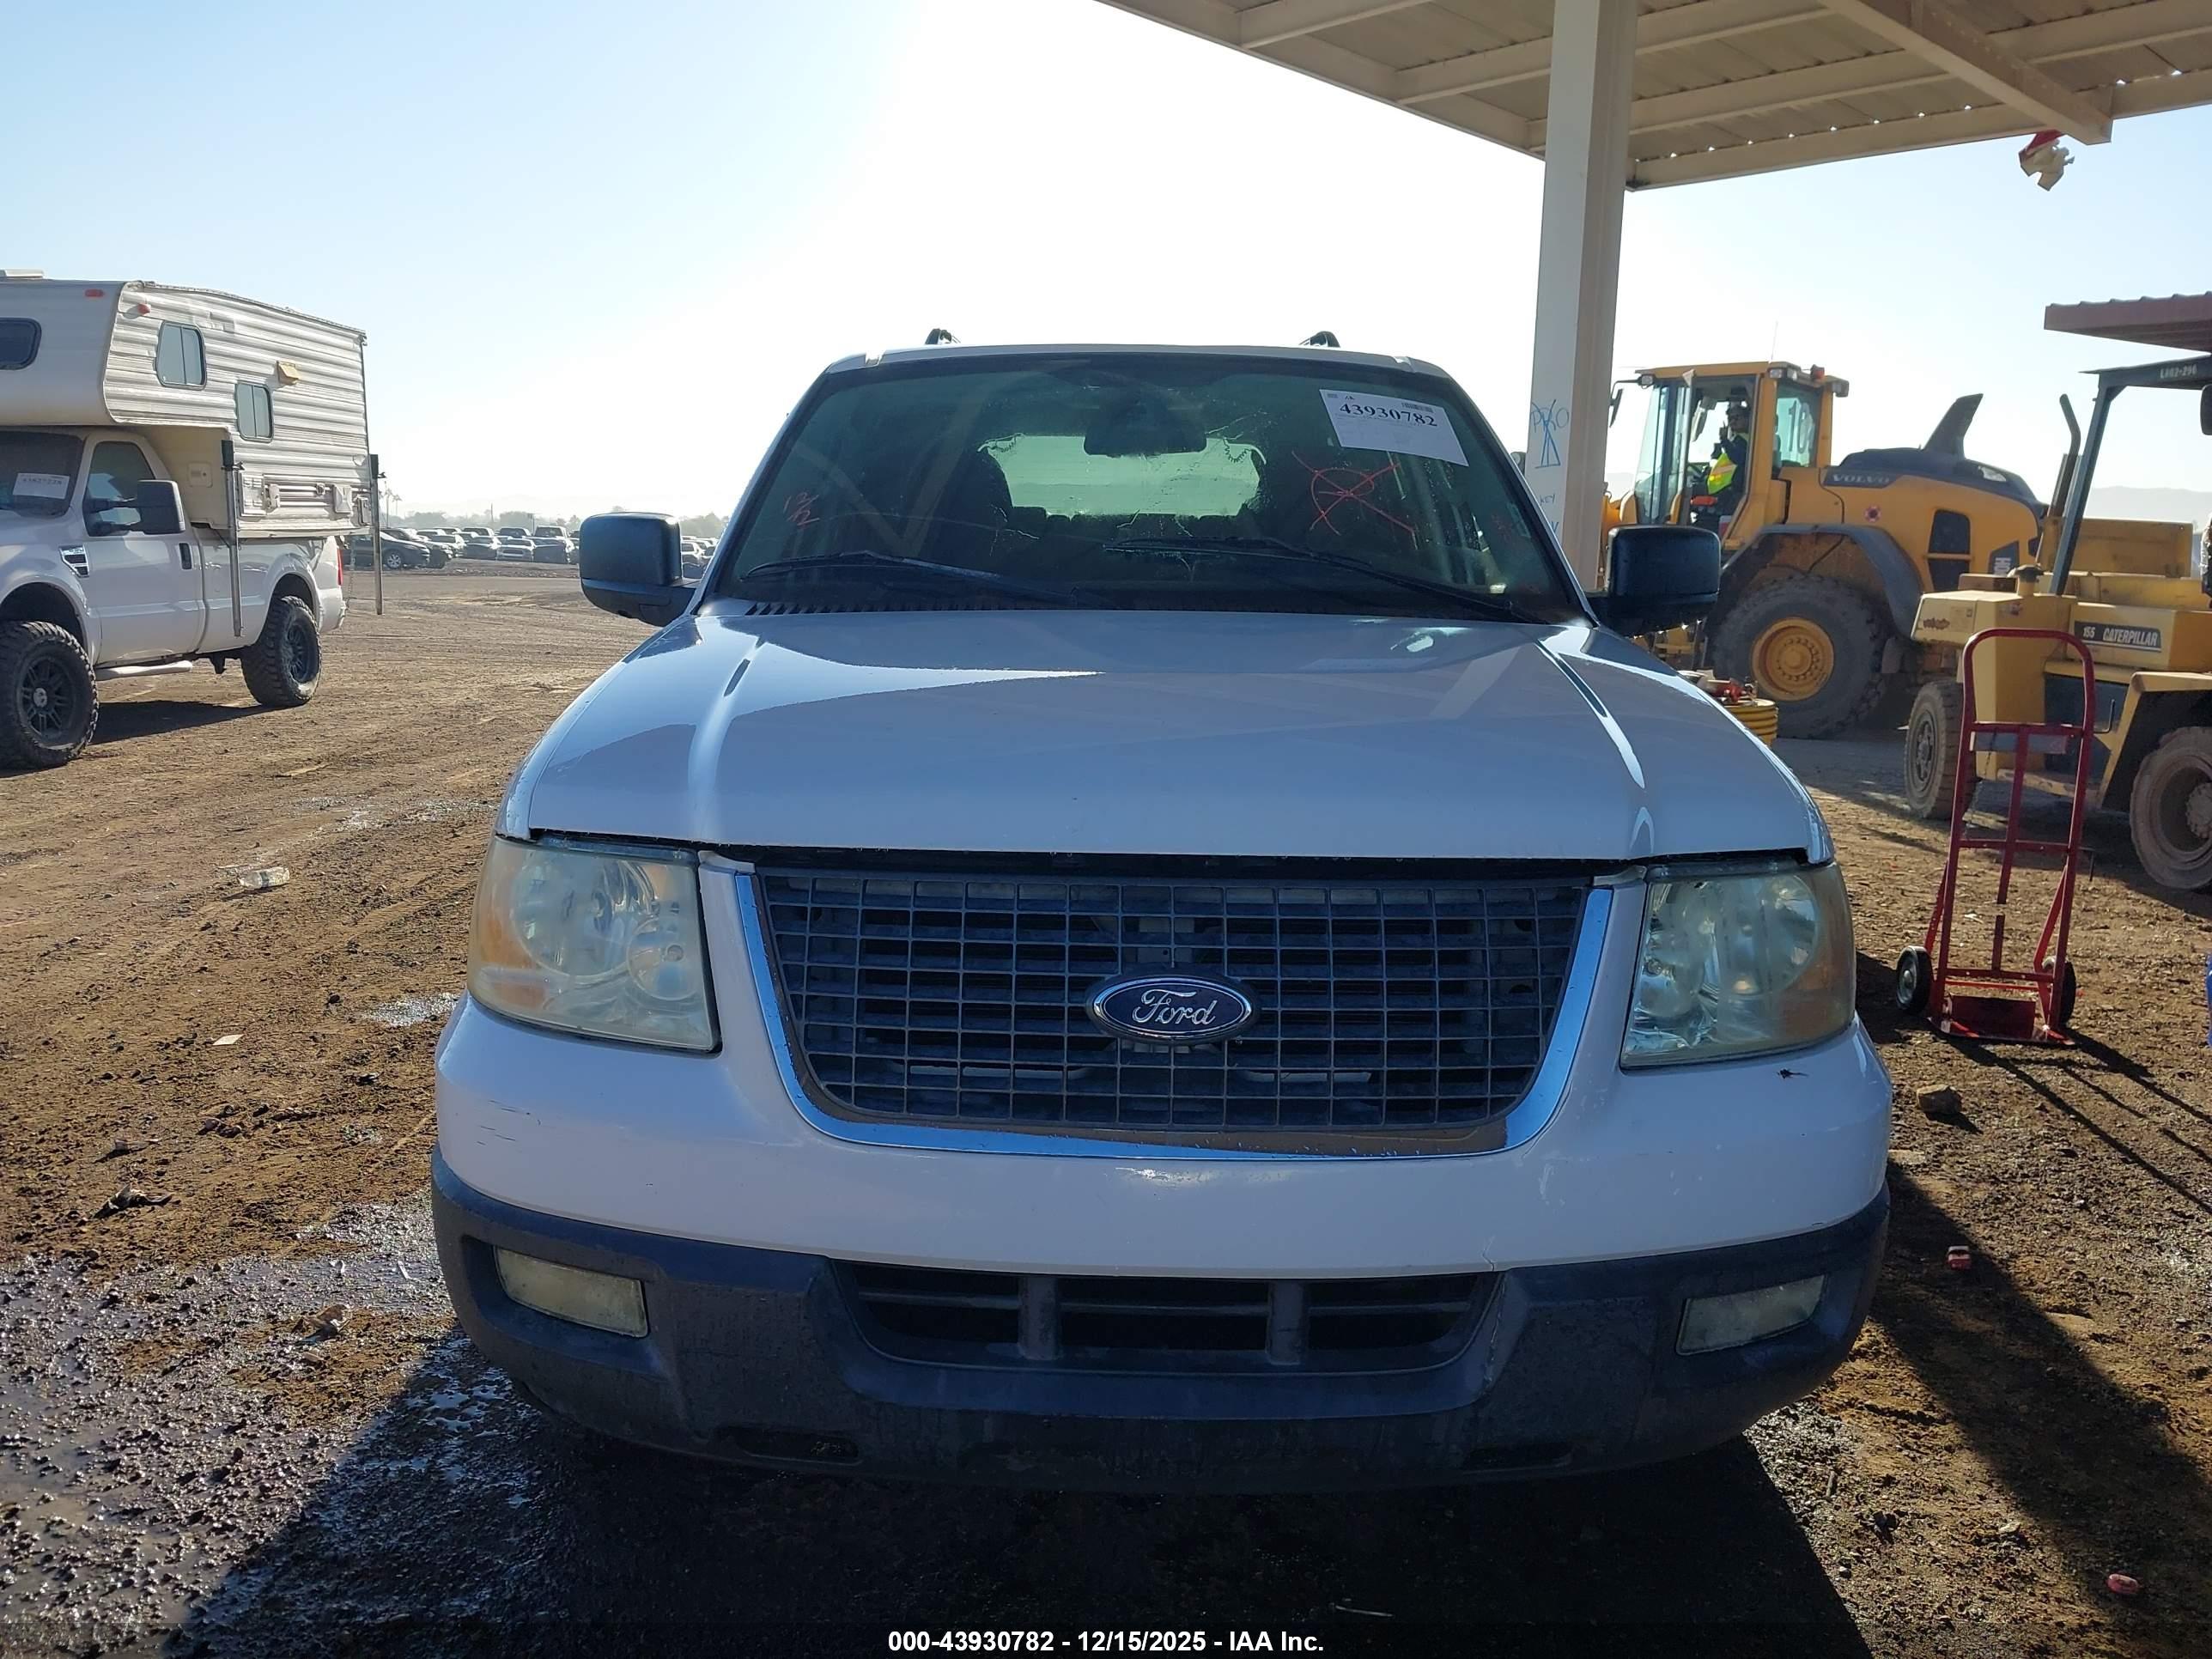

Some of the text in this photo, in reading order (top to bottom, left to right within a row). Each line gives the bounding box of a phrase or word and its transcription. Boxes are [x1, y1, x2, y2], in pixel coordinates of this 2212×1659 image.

[1339, 403, 1438, 427] 43930782
[1832, 473, 1890, 483] VOLVO
[2102, 627, 2159, 647] CATERPILLAR
[1131, 988, 1218, 1025] Ford
